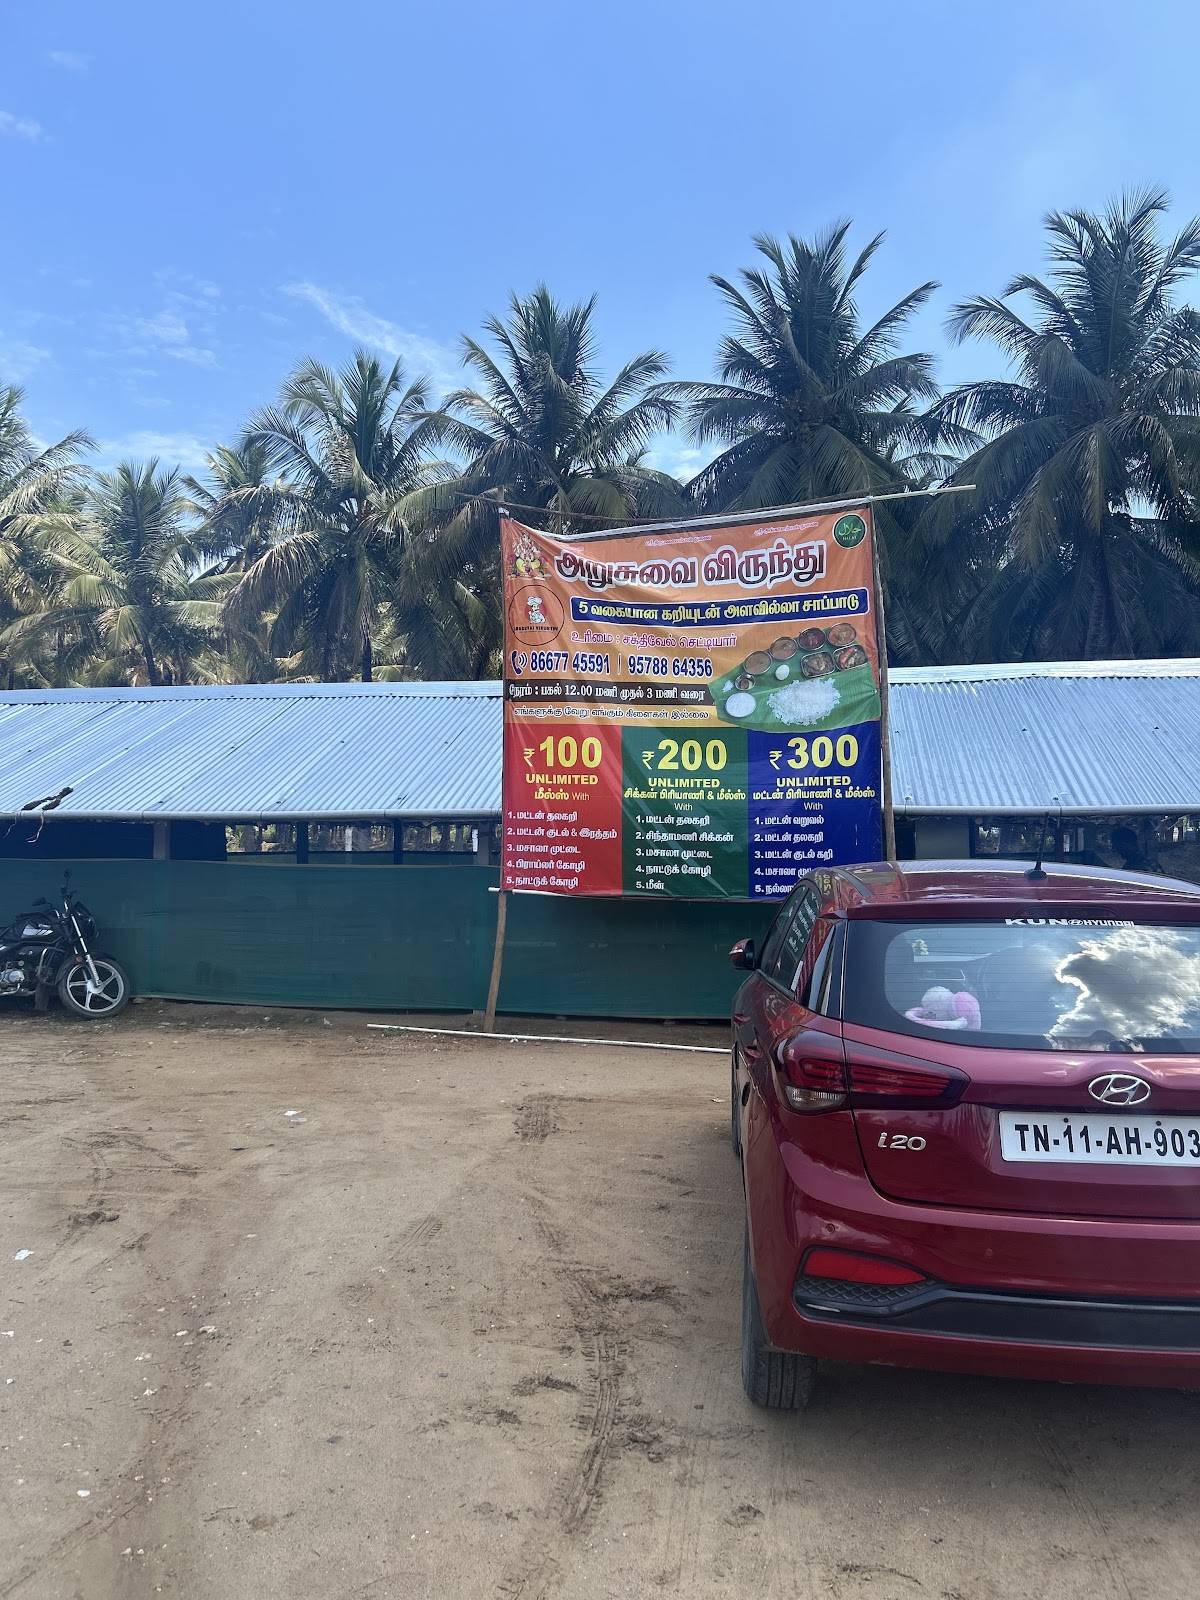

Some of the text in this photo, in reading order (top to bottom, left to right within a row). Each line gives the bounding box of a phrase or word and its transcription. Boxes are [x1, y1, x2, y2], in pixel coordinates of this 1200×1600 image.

[703, 540, 825, 588] விருந்து
[579, 594, 859, 624] 5 வகையான கறியுடன் அளவில்லா சாப்பாடு
[679, 633, 737, 650] செட்டியார்
[530, 651, 714, 678] 86677 45591 95788 64356
[509, 683, 532, 697] நேரம்
[541, 683, 562, 695] பகல்
[564, 685, 593, 697] 12.00
[595, 686, 618, 697] மணி
[620, 685, 644, 700] முதல்
[646, 688, 653, 699] 3
[655, 687, 678, 699] மணி
[680, 690, 706, 702] வரை
[525, 773, 599, 785] UNLIMITED
[649, 778, 721, 788] UNLIMITED
[776, 776, 852, 787] UNLIMITED
[571, 792, 590, 801] With
[707, 790, 714, 800] &
[835, 789, 843, 798] &
[674, 802, 693, 811] With
[803, 802, 823, 811] With
[571, 829, 578, 837] &
[877, 1132, 927, 1151] i20
